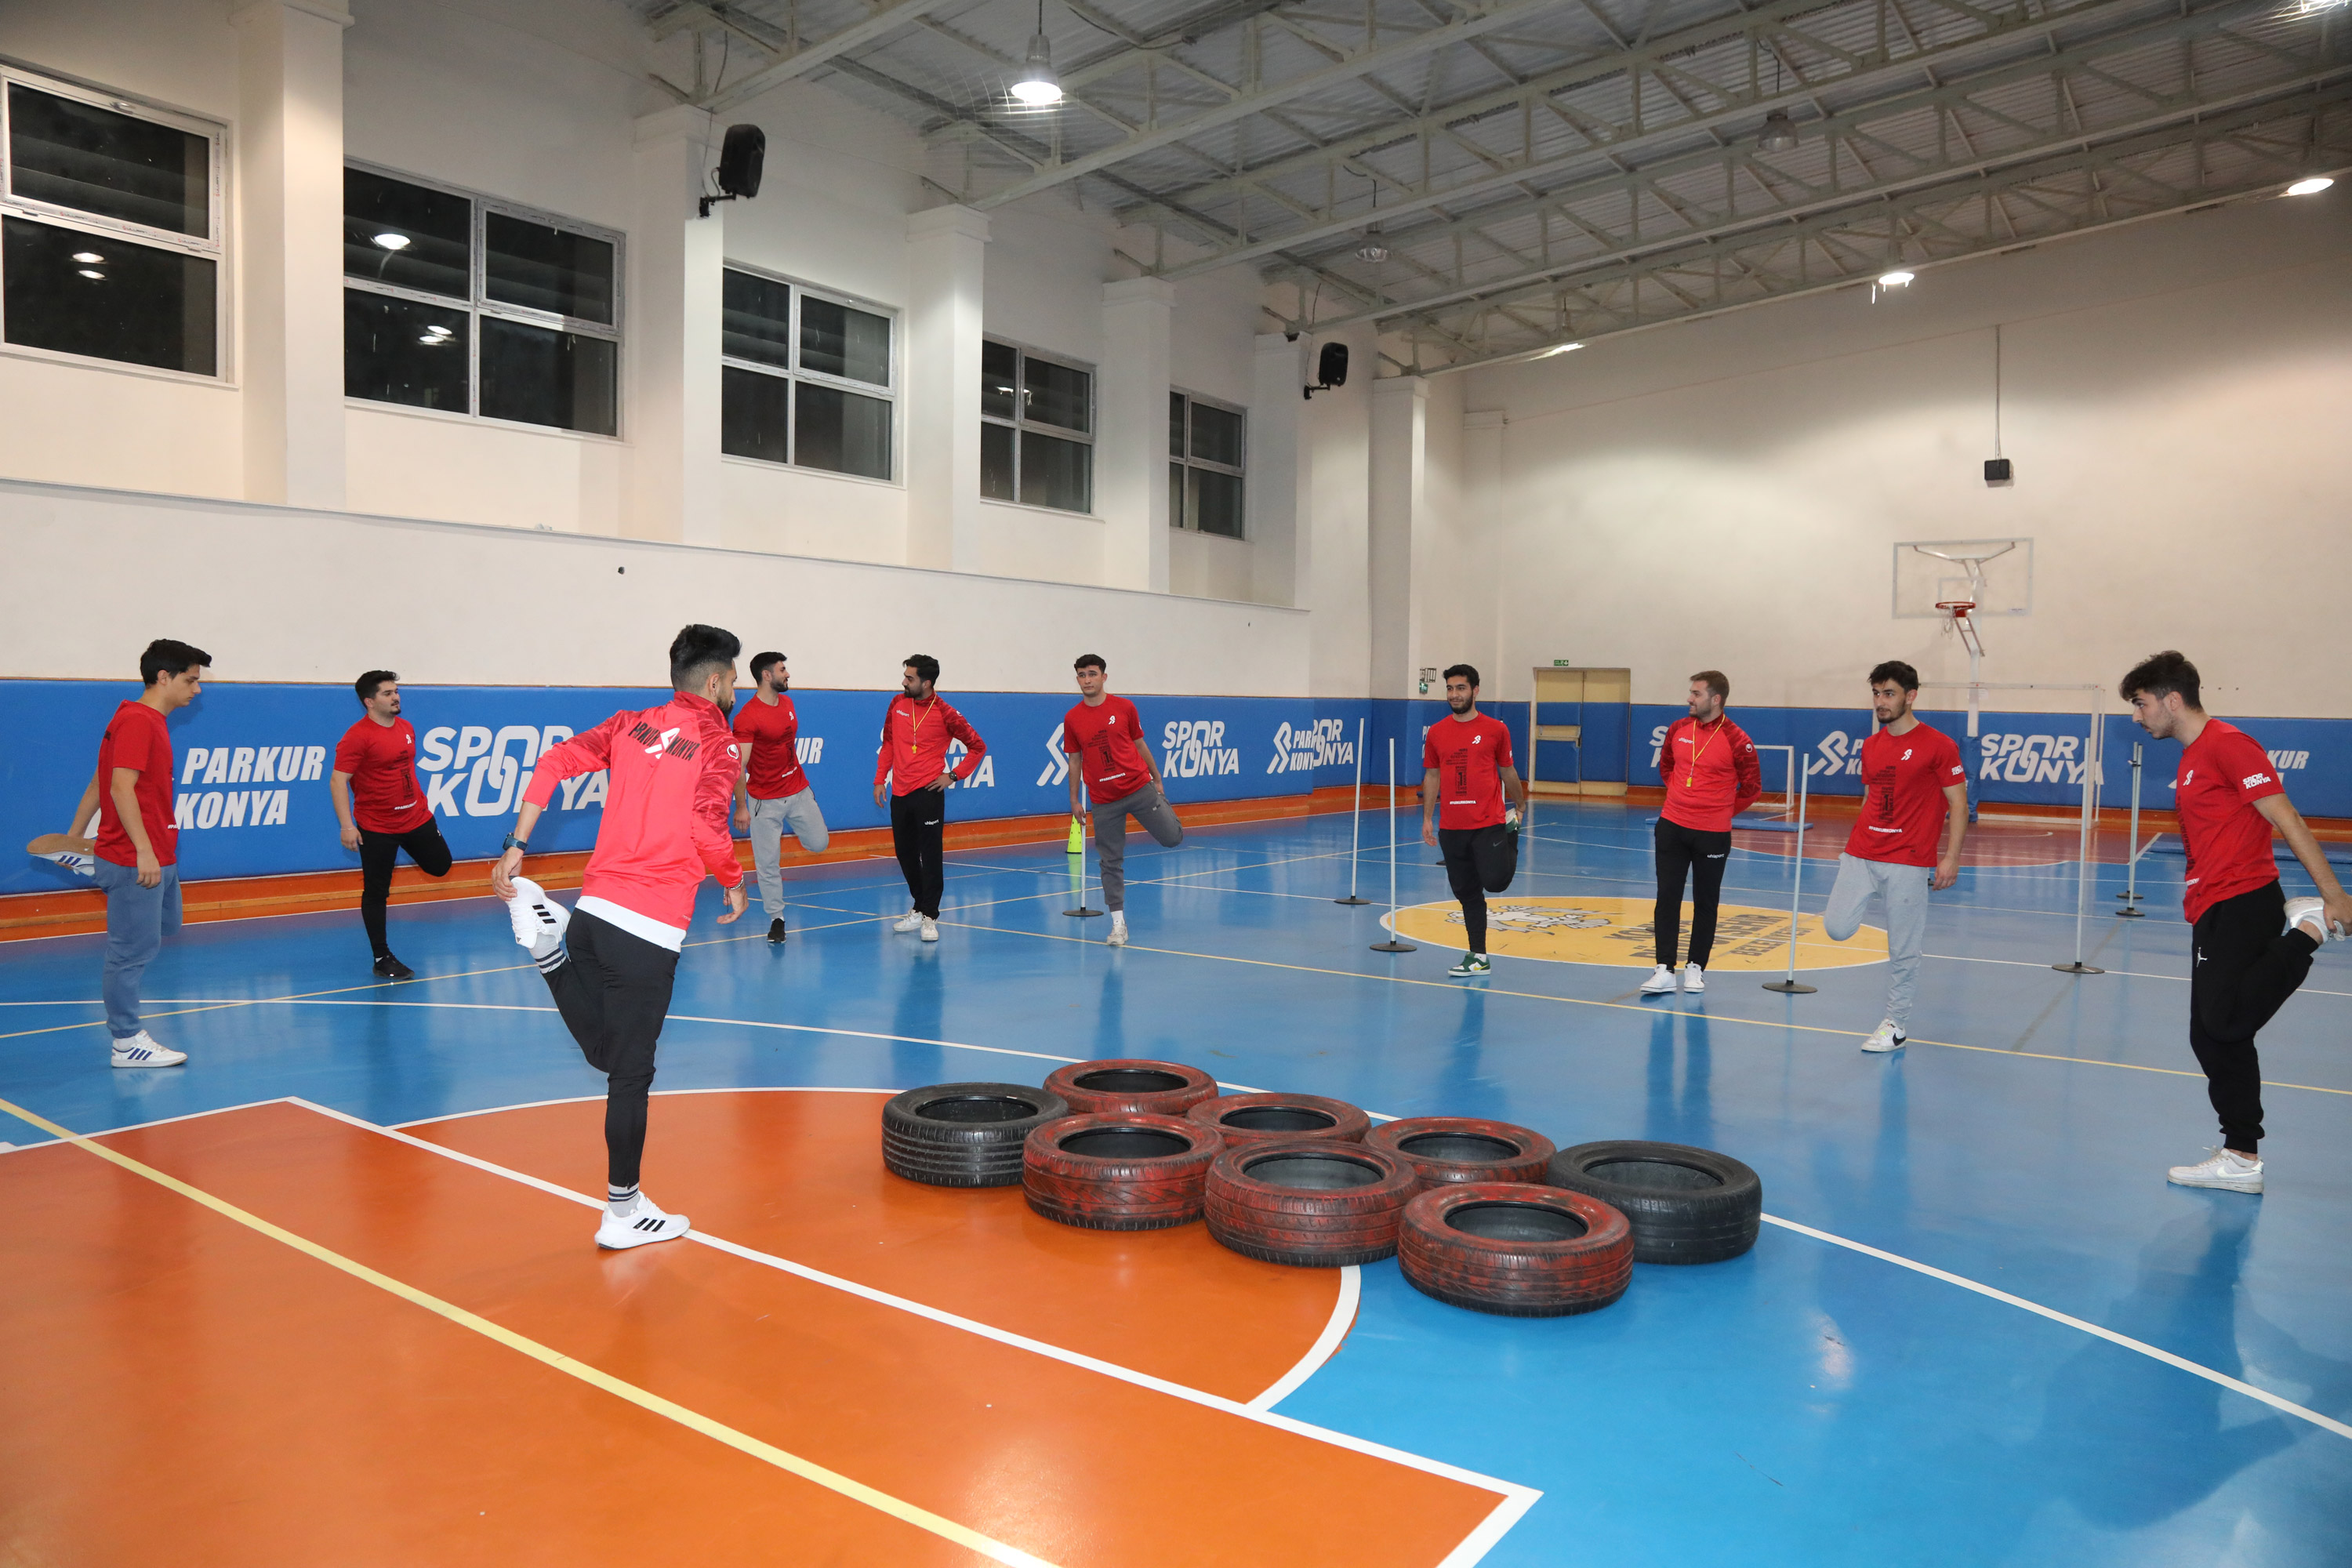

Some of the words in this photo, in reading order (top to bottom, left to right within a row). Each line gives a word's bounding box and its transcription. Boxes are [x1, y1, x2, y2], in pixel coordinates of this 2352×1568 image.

[665, 735, 701, 761] KONYA
[1162, 720, 1225, 760] SPOR
[1163, 739, 1240, 778] KONYA
[1981, 733, 2079, 768] SPOR
[180, 746, 326, 784] PARKUR
[2245, 776, 2272, 789] KONYA
[174, 789, 289, 829] KONYA
